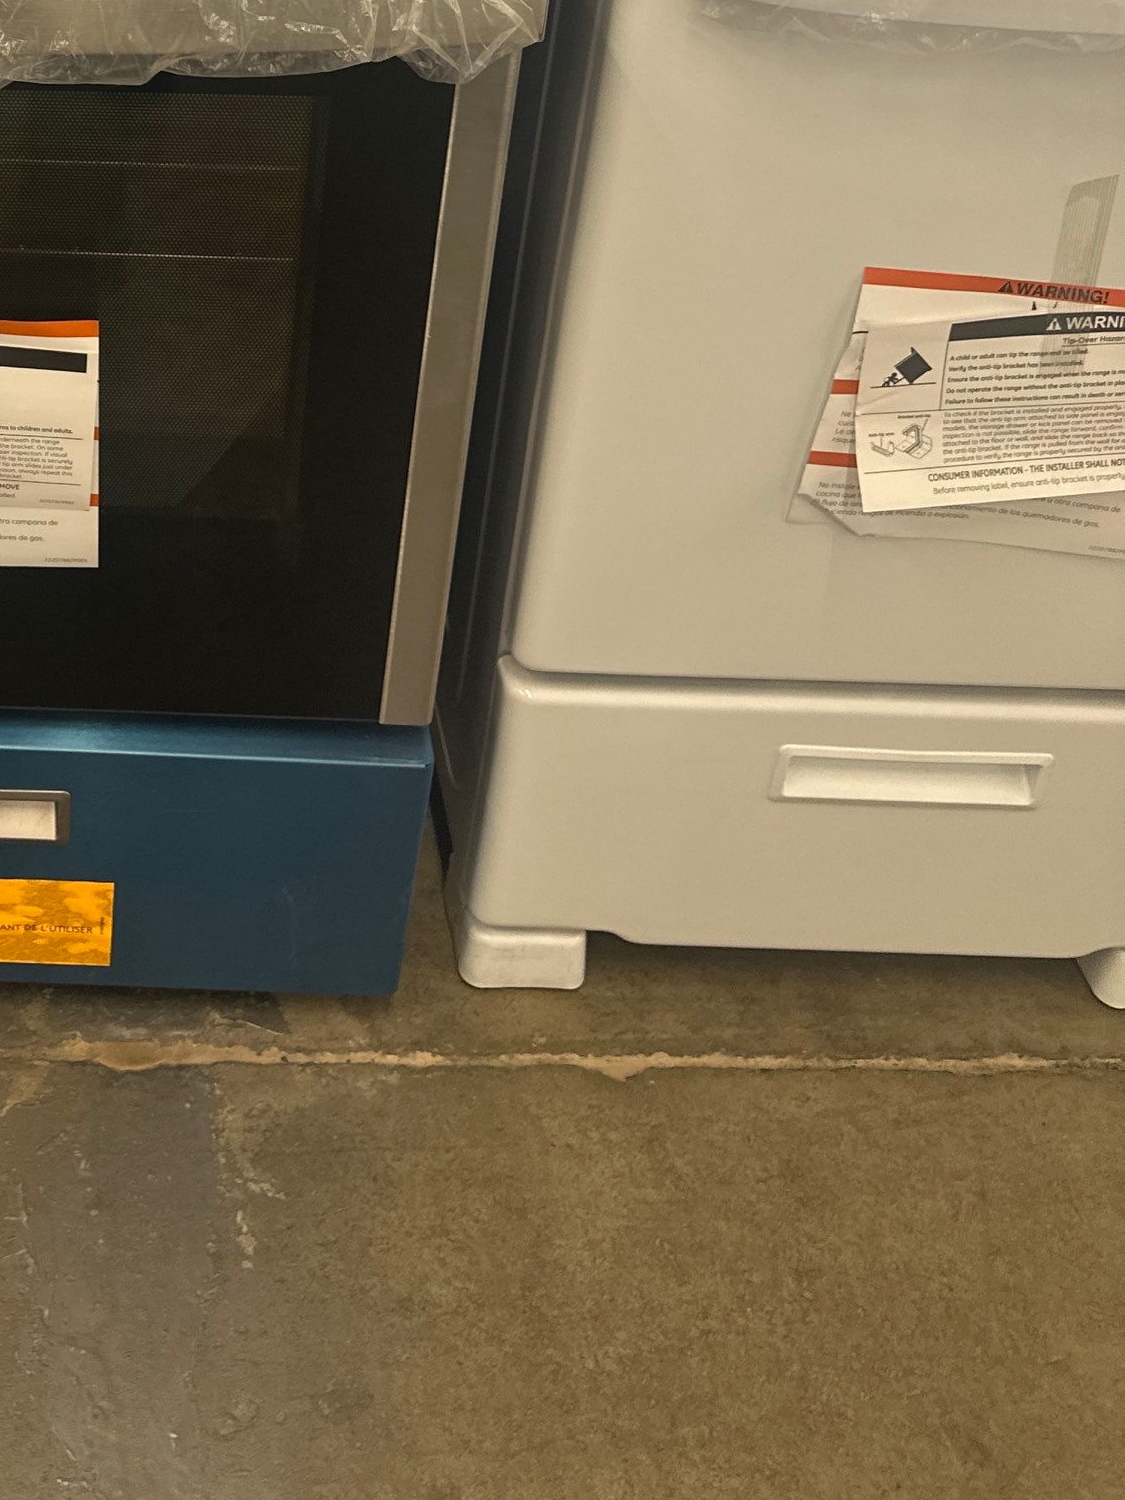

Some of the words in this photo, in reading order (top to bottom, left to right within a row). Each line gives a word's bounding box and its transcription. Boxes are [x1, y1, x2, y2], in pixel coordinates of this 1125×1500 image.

[1016, 282, 1110, 304] WARNING!
[928, 469, 970, 482] CONSUMER
[971, 466, 1024, 478] INFORMATION
[1029, 464, 1044, 473] THE
[1046, 461, 1084, 471] INSTALLER
[1086, 460, 1109, 468] SHALL
